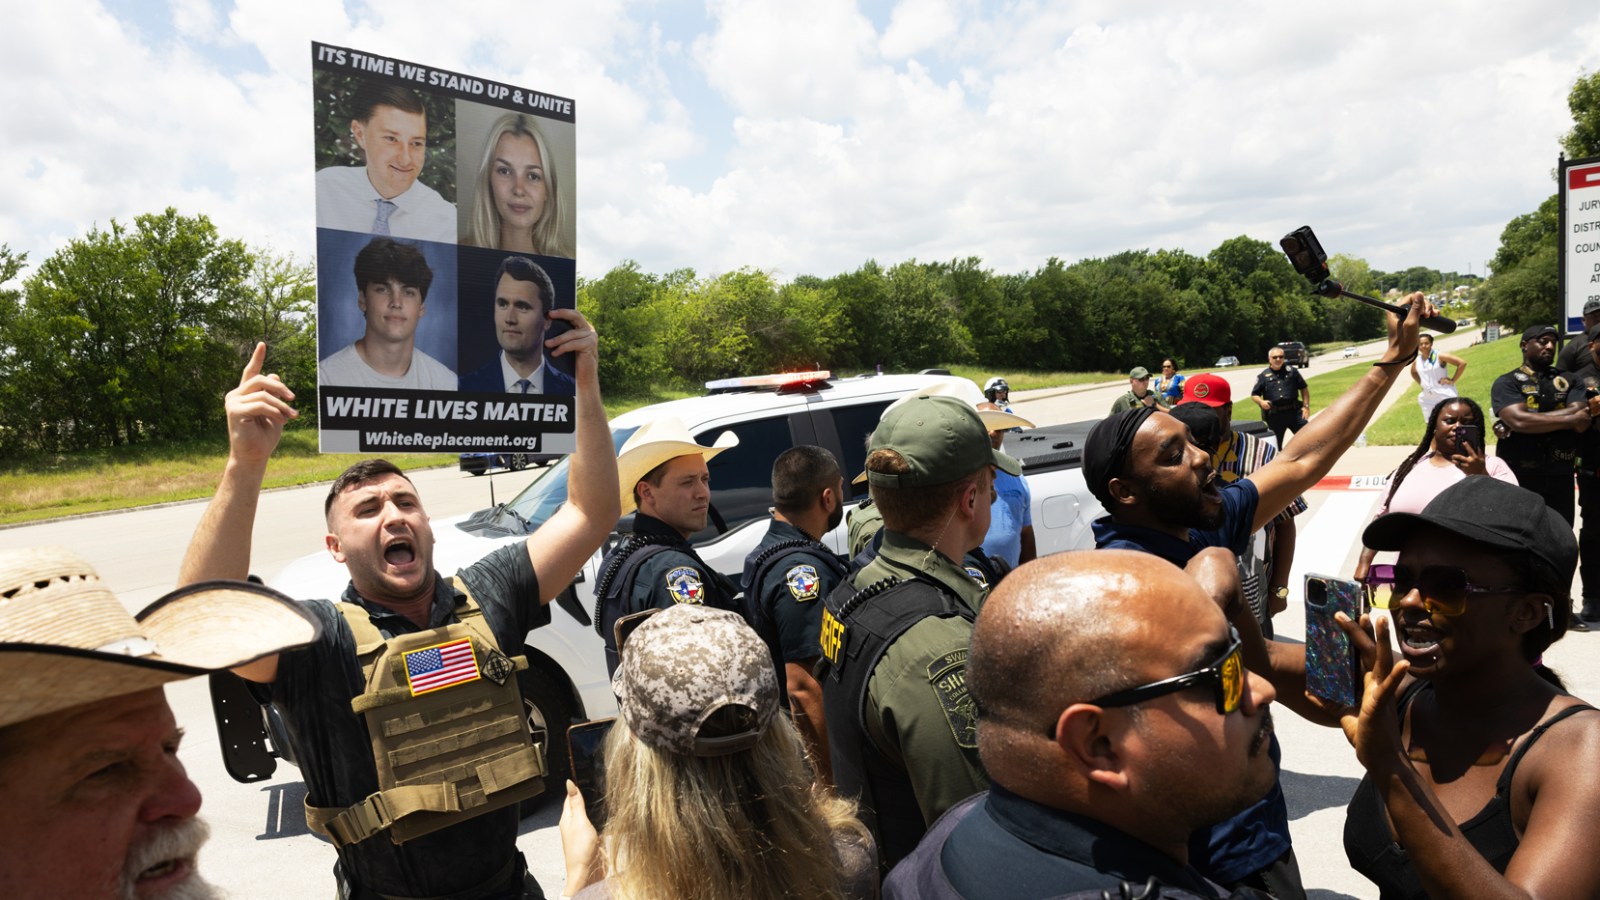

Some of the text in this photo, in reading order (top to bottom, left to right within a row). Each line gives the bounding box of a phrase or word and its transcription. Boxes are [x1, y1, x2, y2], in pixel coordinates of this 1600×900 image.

[318, 46, 571, 115] ITS TIME WE STAND UP & UNITE
[326, 396, 568, 422] WHITE LIVES MATTER
[365, 431, 537, 449] WhiteReplacement.org
